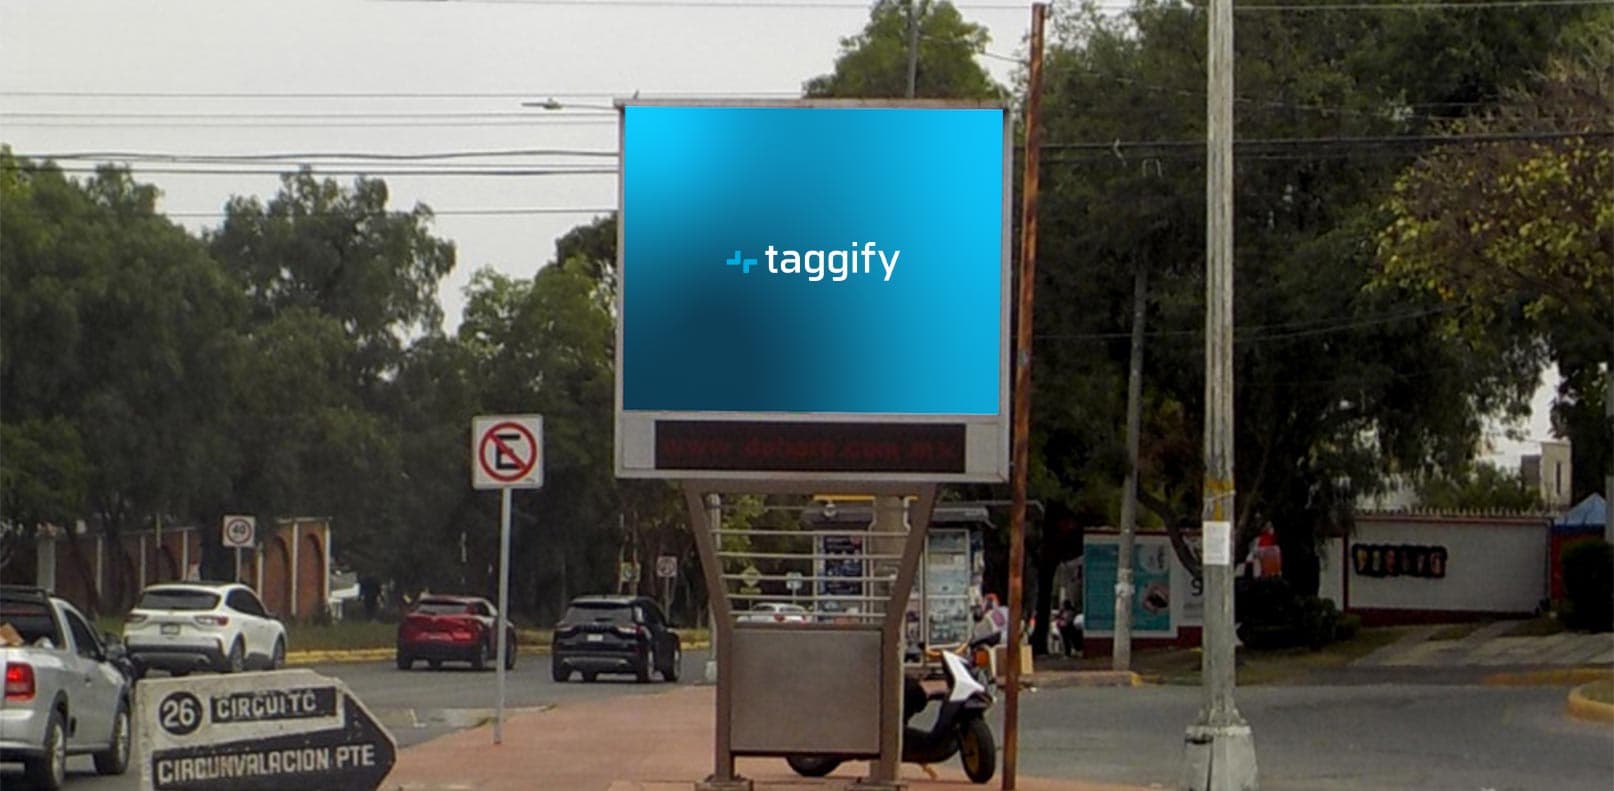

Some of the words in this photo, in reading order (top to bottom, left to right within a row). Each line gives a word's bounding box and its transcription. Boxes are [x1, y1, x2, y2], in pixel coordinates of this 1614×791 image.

[764, 241, 900, 282] taggify
[231, 524, 247, 536] 40
[163, 698, 196, 727] 26
[157, 747, 329, 785] CIRCUNVALACION
[336, 744, 375, 768] PTE
